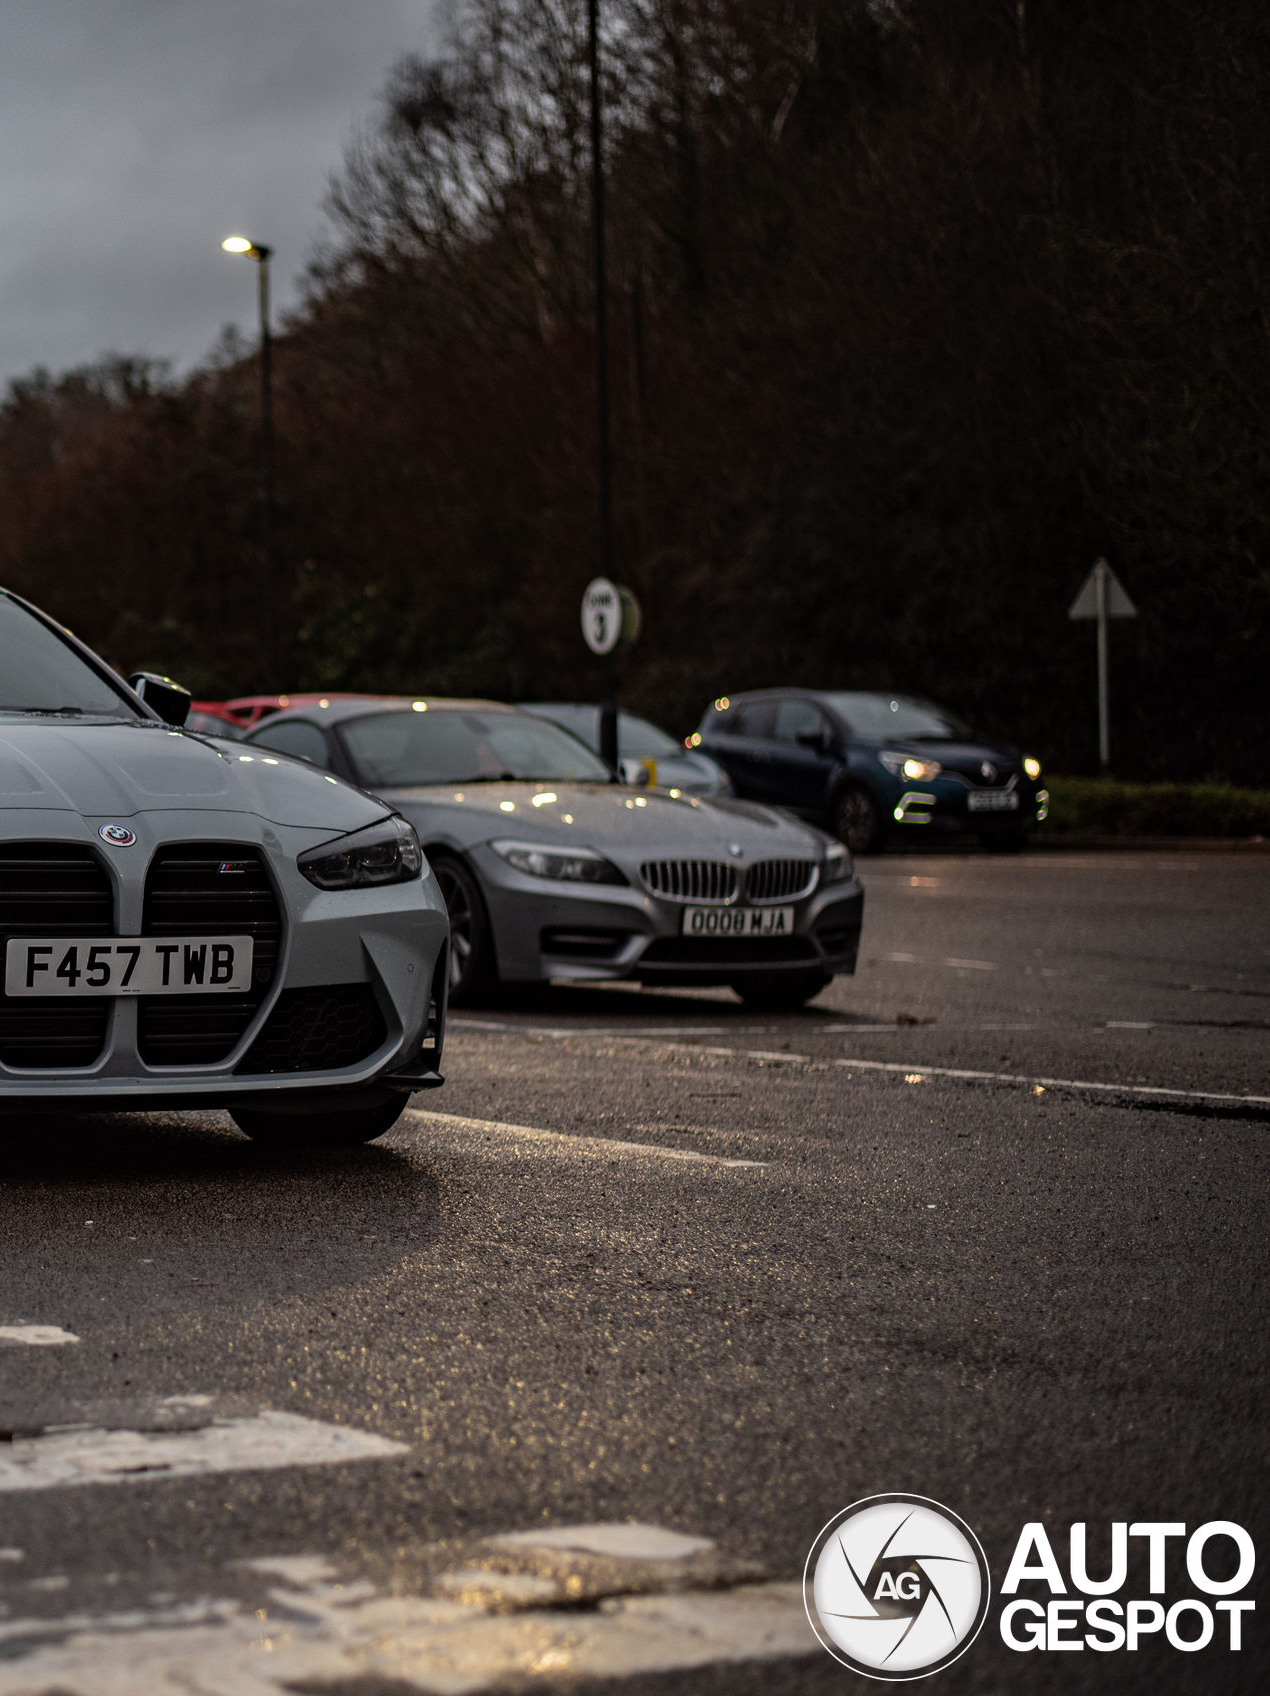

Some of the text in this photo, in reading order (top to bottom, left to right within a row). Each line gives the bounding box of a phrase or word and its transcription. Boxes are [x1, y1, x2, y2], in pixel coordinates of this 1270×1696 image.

[750, 908, 786, 933] MJA
[26, 944, 235, 987] F457 TWB
